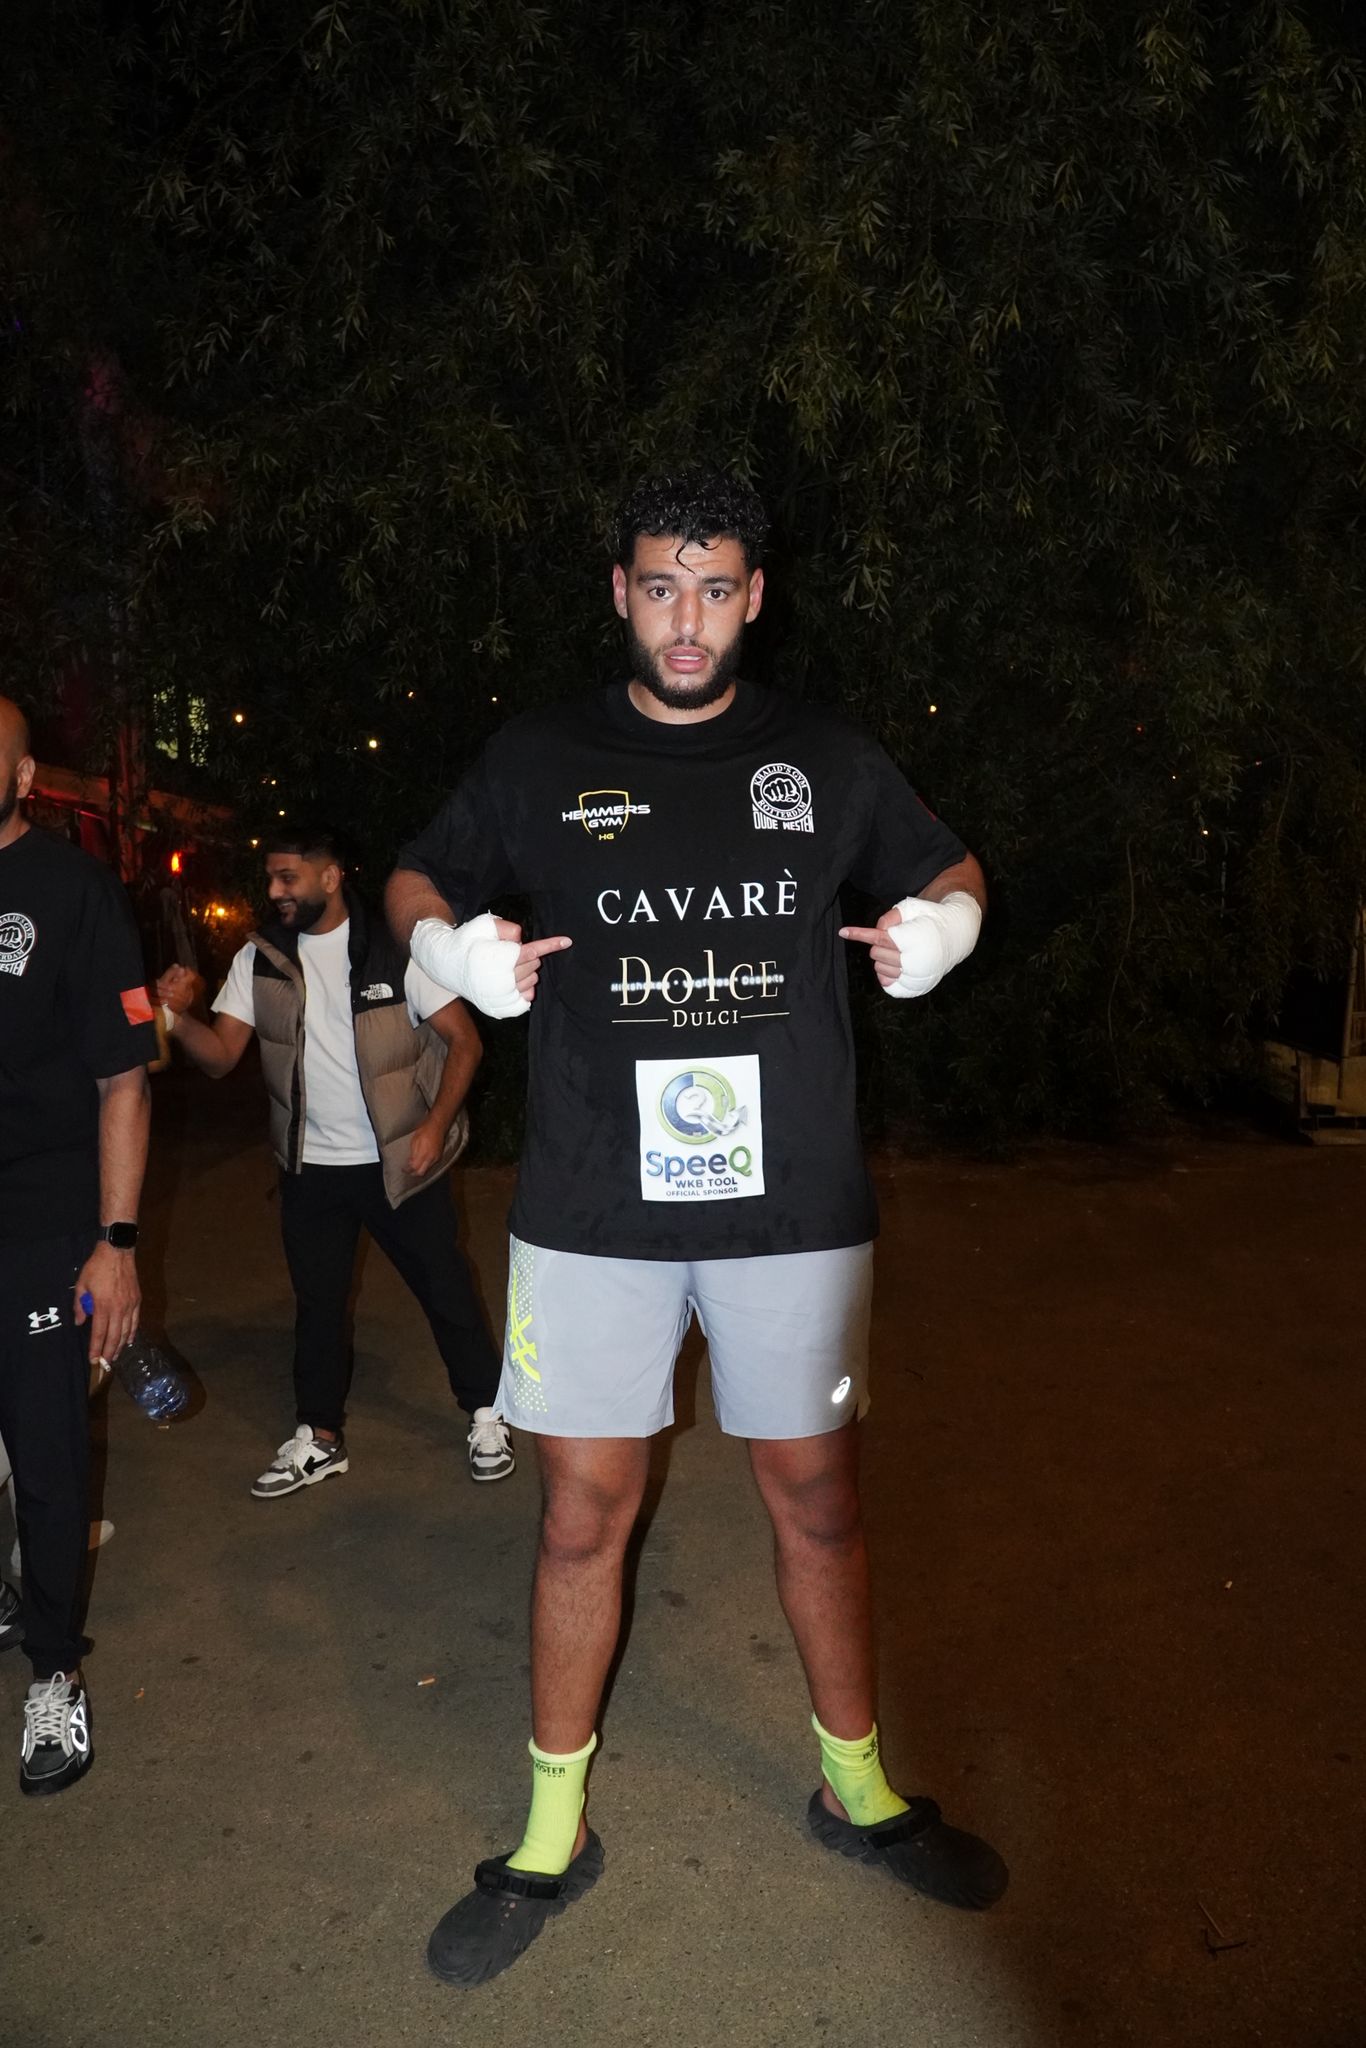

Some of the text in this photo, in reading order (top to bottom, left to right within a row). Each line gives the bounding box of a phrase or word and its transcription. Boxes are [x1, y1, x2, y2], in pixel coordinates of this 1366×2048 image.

[753, 765, 807, 788] KHALID'S GYM
[562, 805, 651, 822] HEMMERS
[758, 799, 807, 819] ROTTERDAM
[588, 816, 623, 828] GYM
[598, 833, 615, 841] HG
[597, 868, 798, 925] CAVARÈ
[646, 1146, 752, 1183] SpeeQ
[675, 1177, 738, 1189] WKB TOOL
[703, 1187, 738, 1196] SPONSOR
